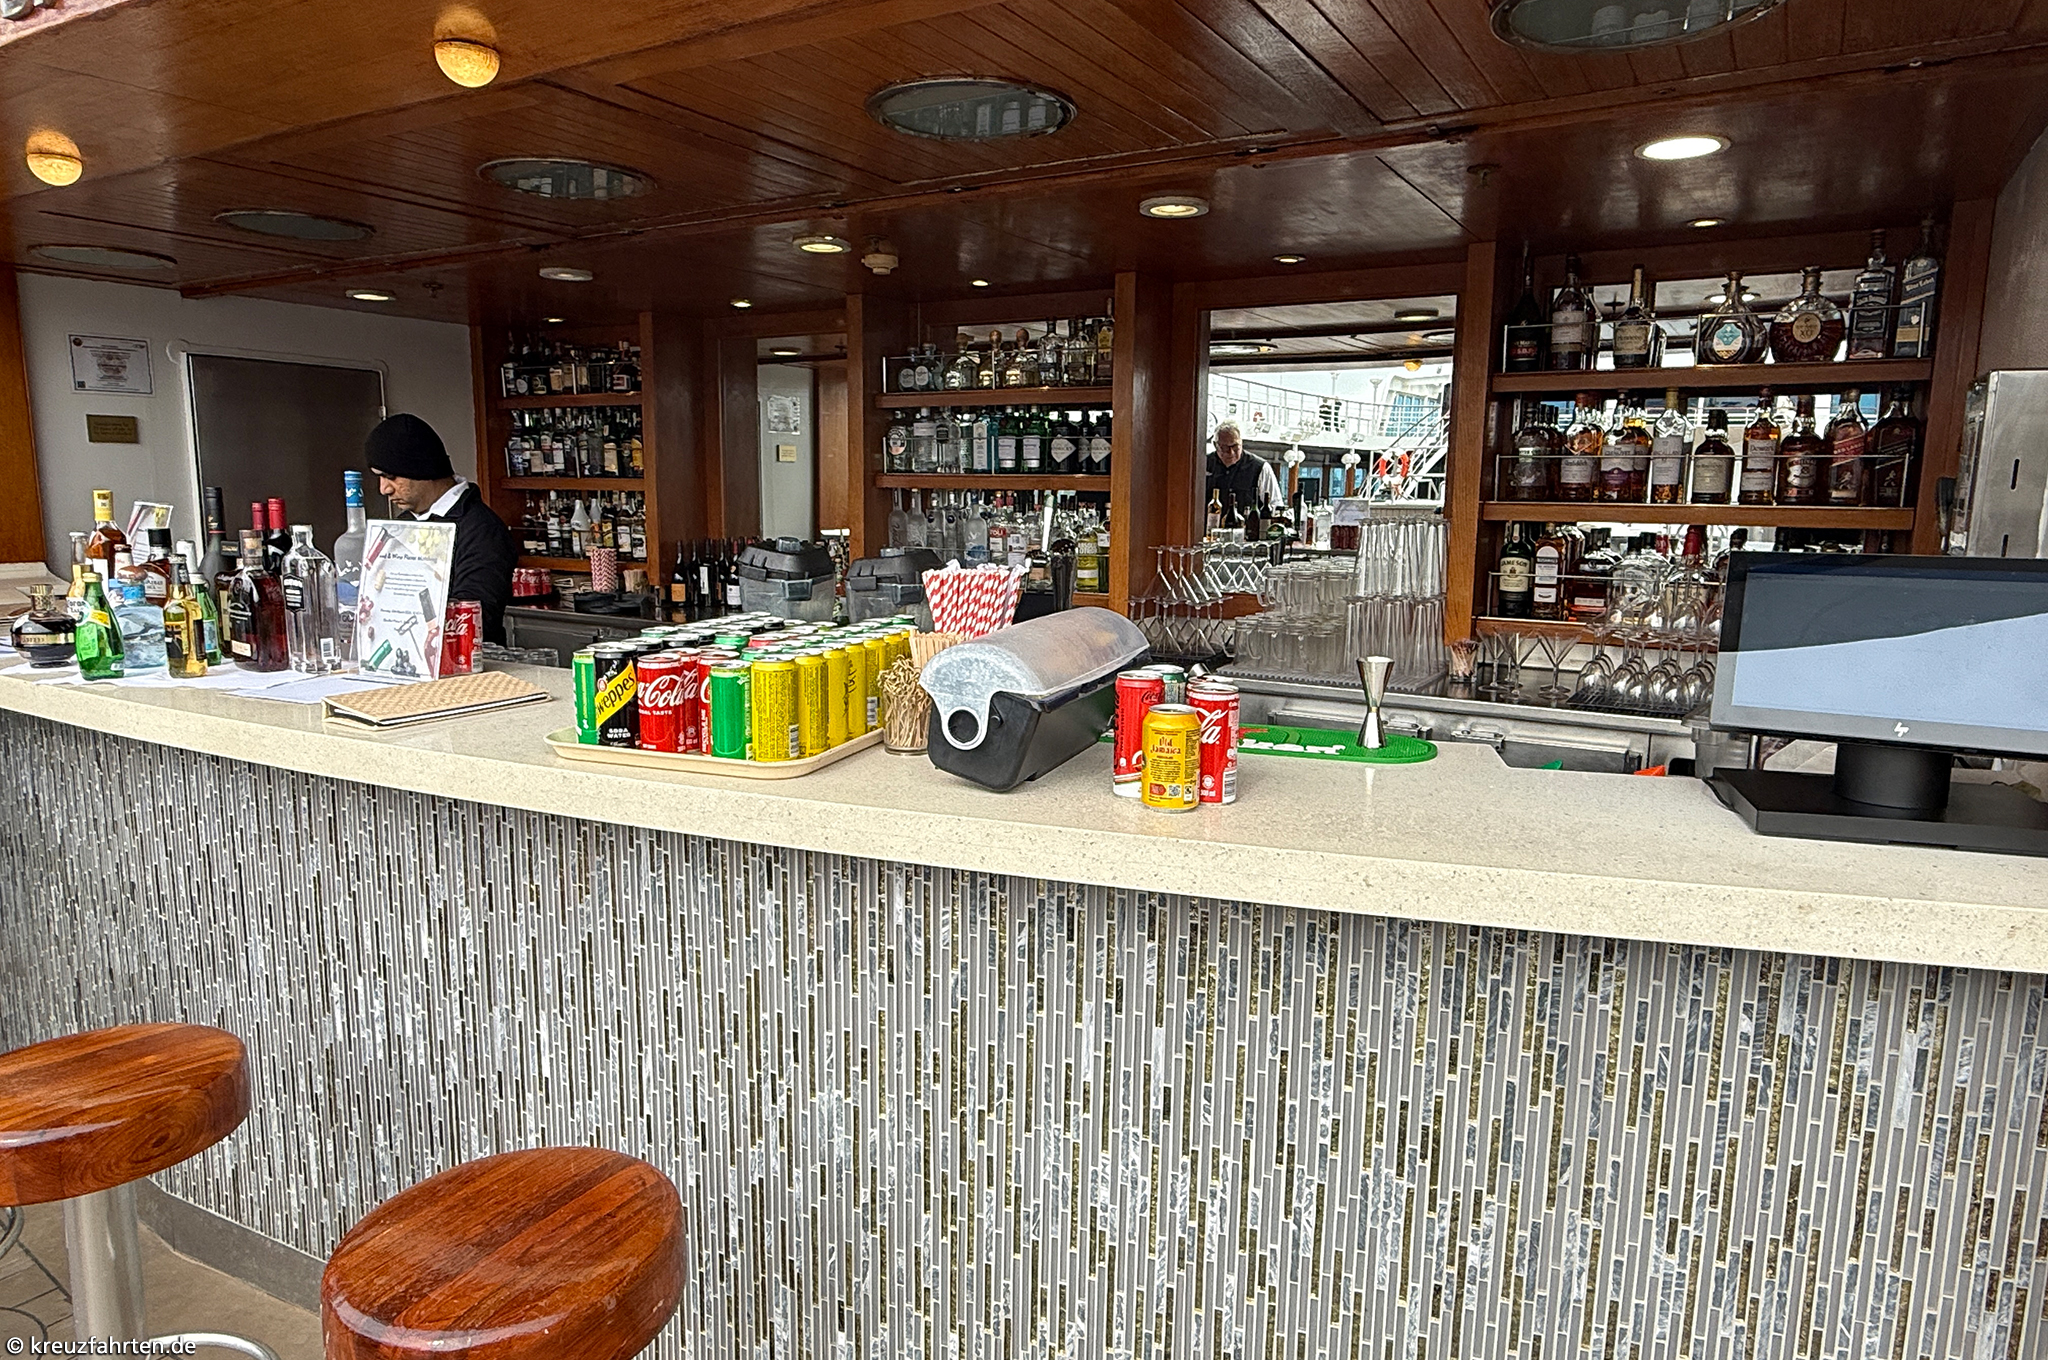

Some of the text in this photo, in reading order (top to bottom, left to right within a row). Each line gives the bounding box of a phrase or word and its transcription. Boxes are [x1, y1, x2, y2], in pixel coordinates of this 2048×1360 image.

[1501, 558, 1528, 568] JAMESON
[597, 671, 636, 717] weppes
[1150, 744, 1181, 755] Jamaica
